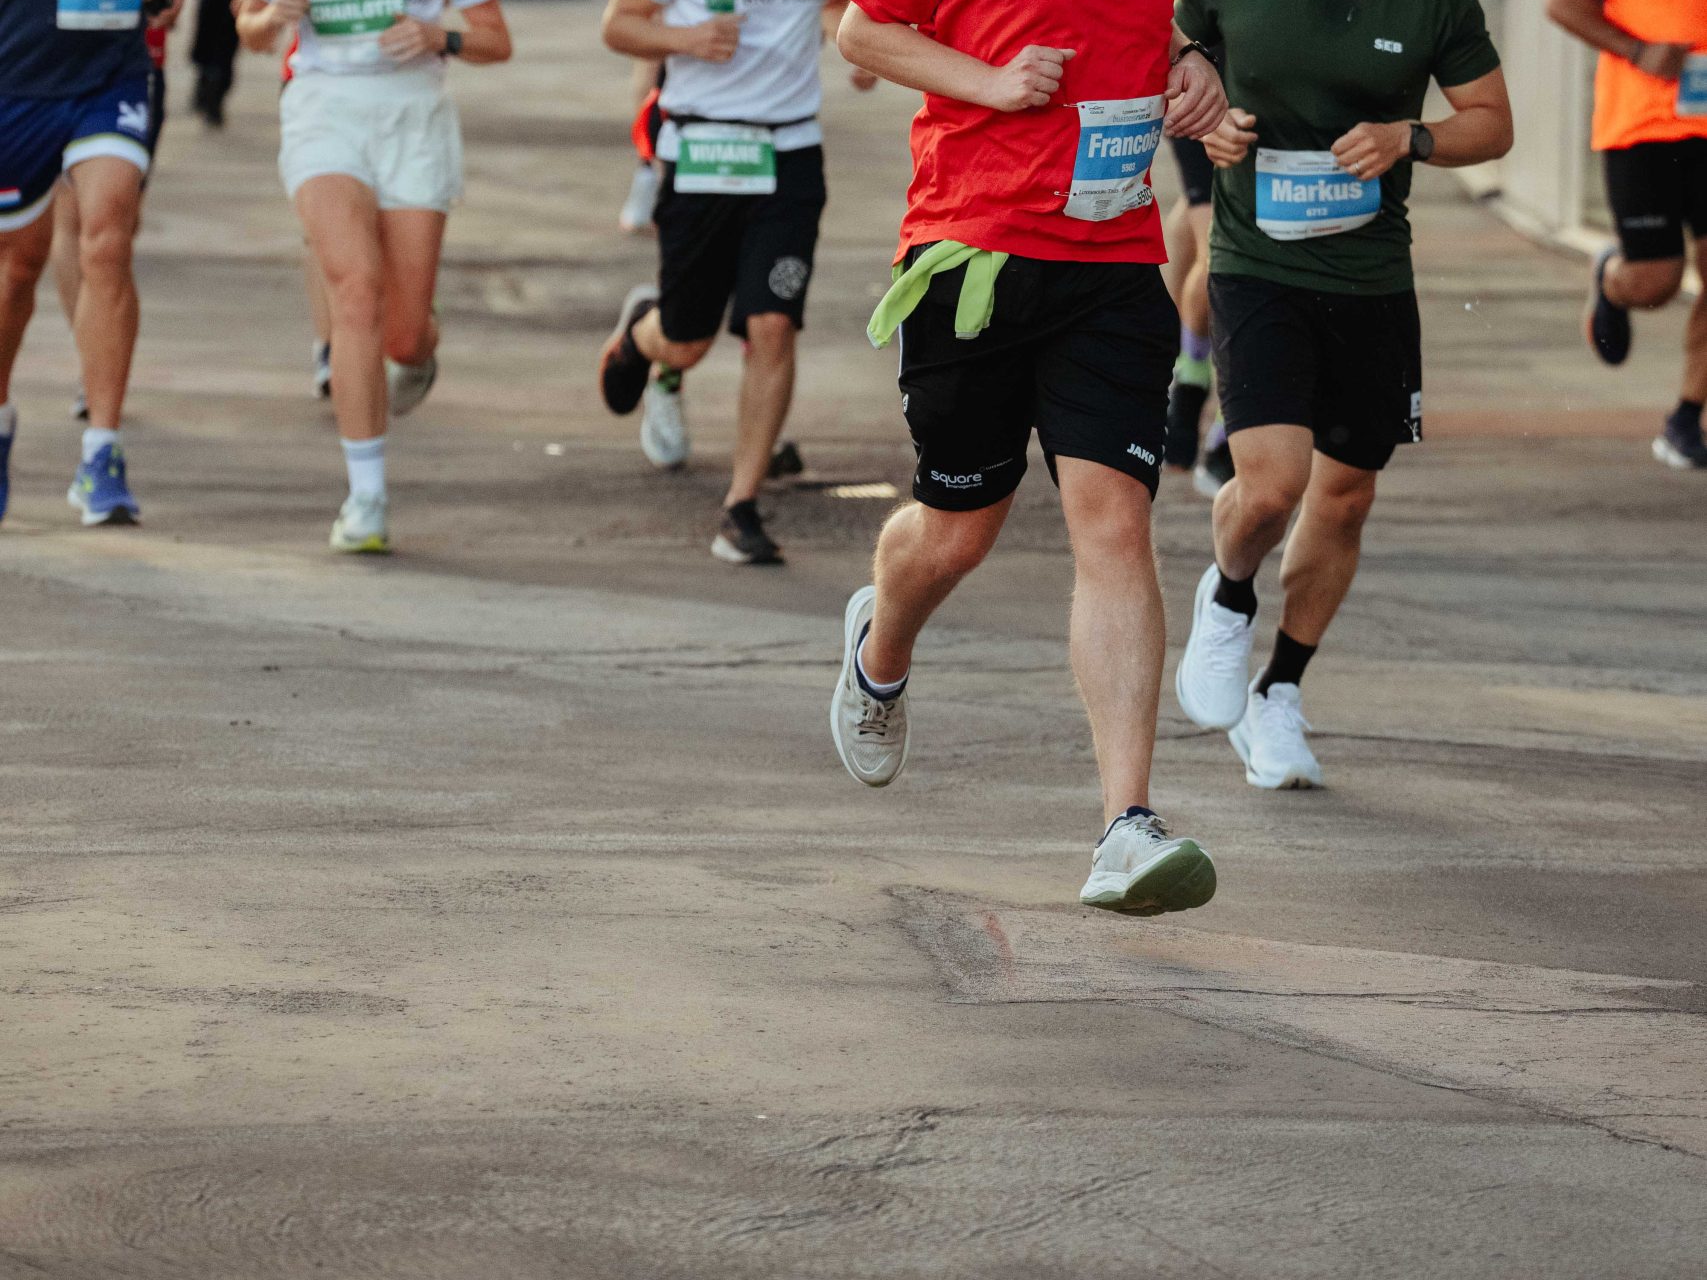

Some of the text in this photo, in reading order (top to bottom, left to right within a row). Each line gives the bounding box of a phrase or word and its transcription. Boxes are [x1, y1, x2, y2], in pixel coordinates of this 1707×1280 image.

[1374, 38, 1402, 53] SEB
[1087, 126, 1160, 158] Francois
[1136, 186, 1152, 205] 5503
[1271, 178, 1364, 203] Markus
[1126, 443, 1155, 466] JAKO
